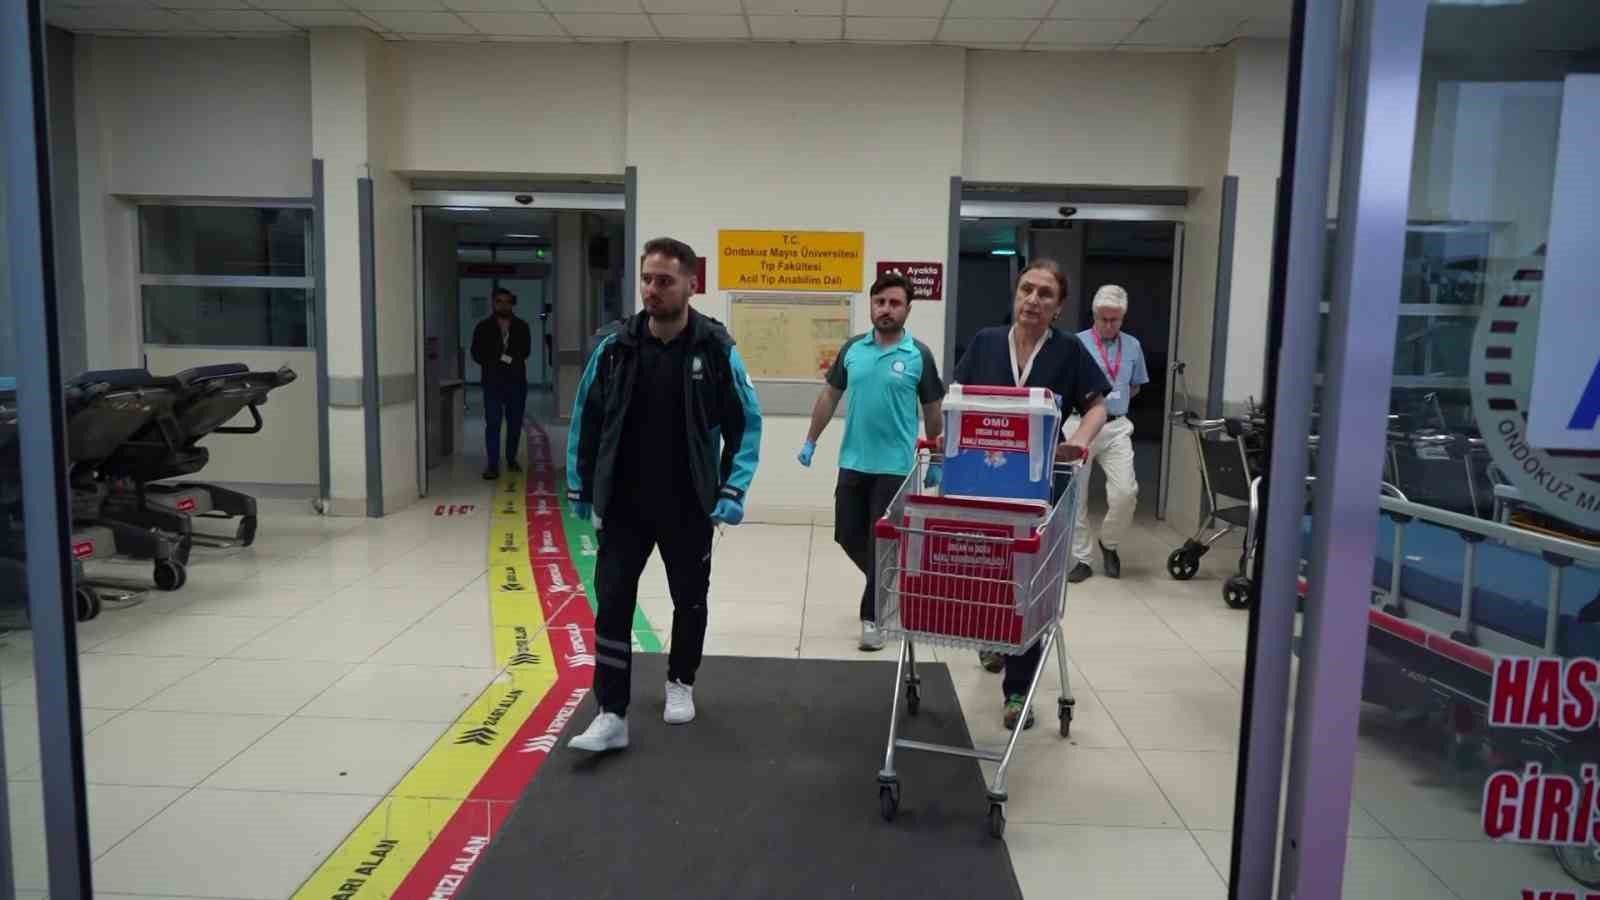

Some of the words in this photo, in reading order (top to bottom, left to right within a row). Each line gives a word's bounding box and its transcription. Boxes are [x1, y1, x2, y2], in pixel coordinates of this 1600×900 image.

[783, 235, 800, 244] T.C.
[801, 246, 858, 259] Üniversitesi
[740, 274, 758, 283] Acil
[778, 275, 821, 284] Anabilim
[824, 276, 842, 285] Dalı
[778, 262, 822, 272] Fakültesi
[1498, 420, 1574, 502] ONDOKUZ
[1488, 657, 1600, 732] HAS
[1483, 763, 1600, 844] GİRİ
[354, 839, 400, 876] ALAN
[449, 836, 489, 873] ALAN
